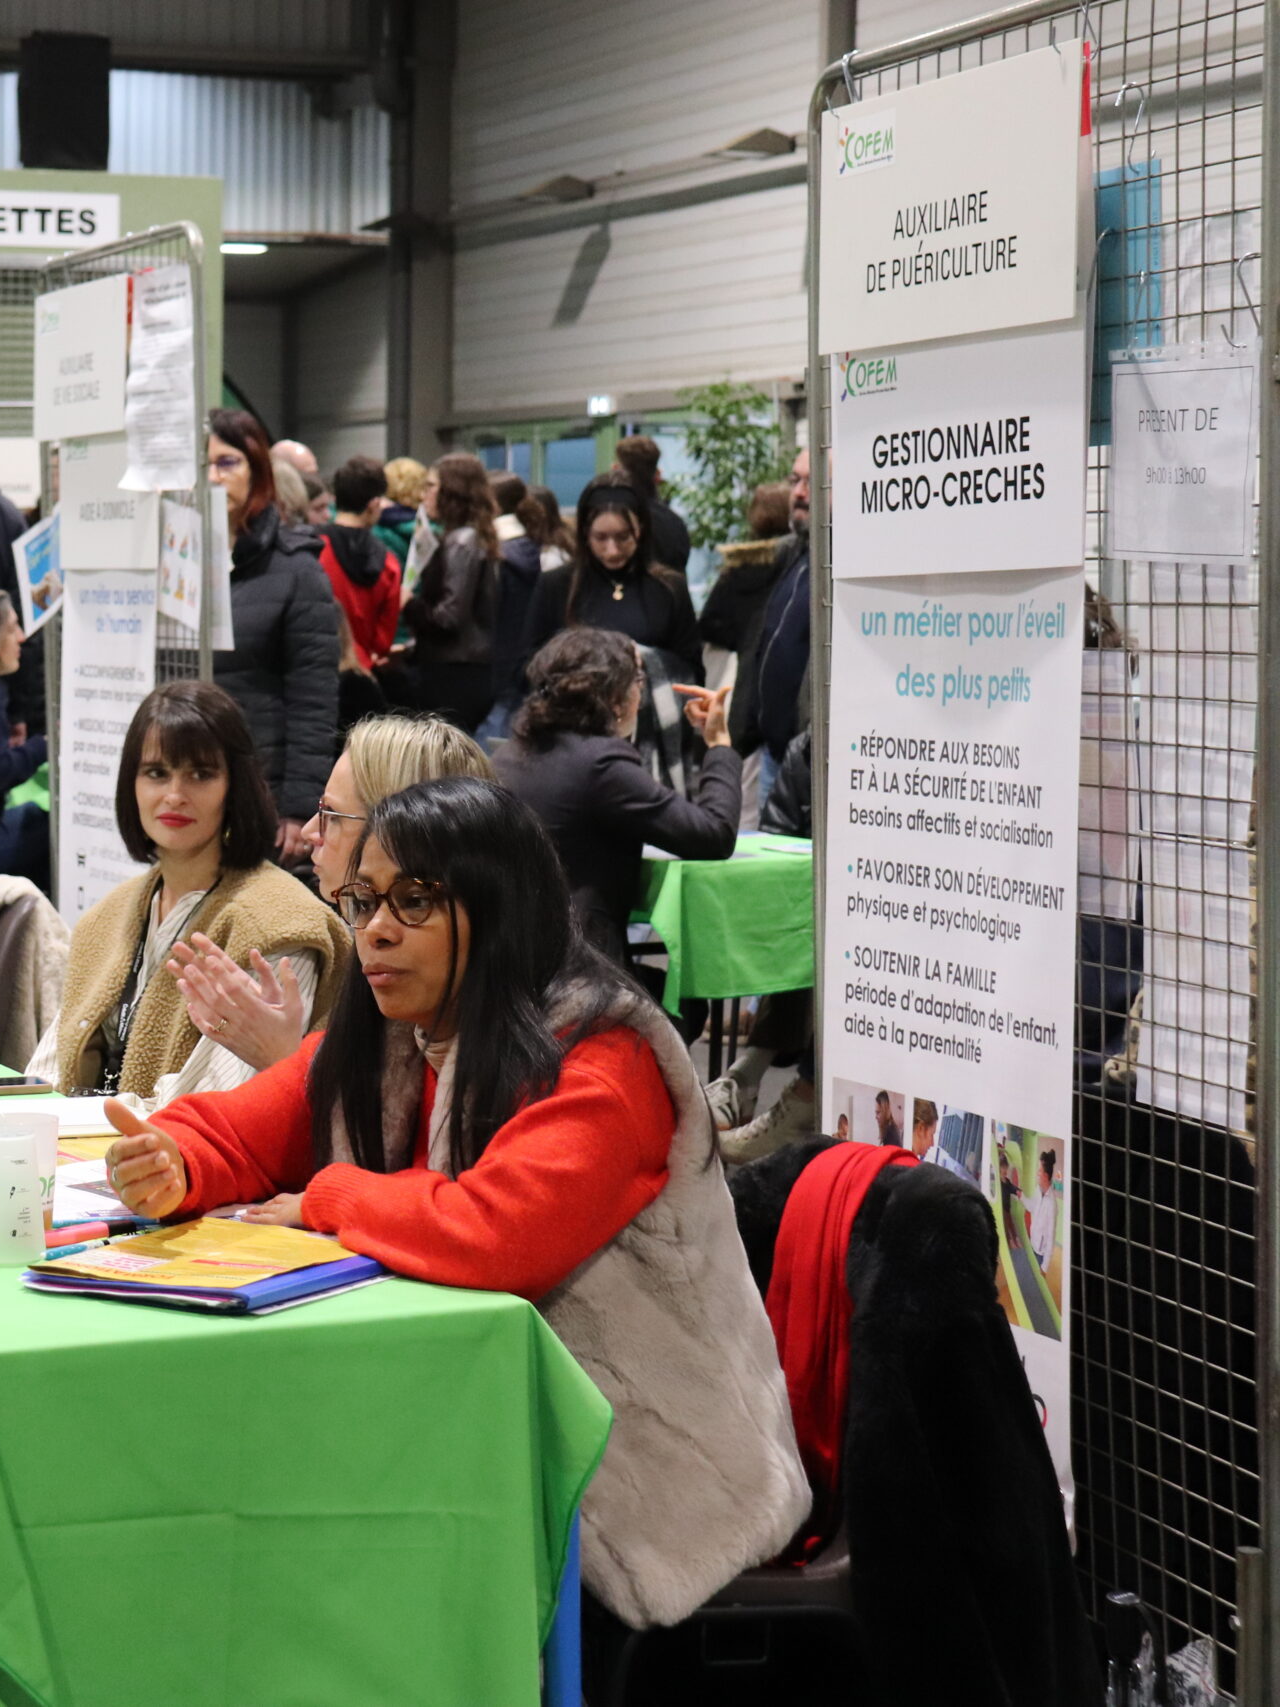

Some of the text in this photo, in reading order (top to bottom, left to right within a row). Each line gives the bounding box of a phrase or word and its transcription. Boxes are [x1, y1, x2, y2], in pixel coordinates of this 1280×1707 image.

[845, 128, 893, 168] COFEM
[893, 190, 988, 240] AUXILIAIRE
[866, 235, 1017, 293] DE PUÉRICULTURE
[846, 356, 898, 397] COFEM
[872, 416, 1030, 468] GESTIONNAIRE
[1195, 407, 1219, 431] DE
[861, 462, 1045, 514] MICRO-CRECHES
[1146, 467, 1166, 484] 9h00
[1174, 466, 1206, 484] 13h00
[860, 599, 1066, 646] un métier pour l'éveil
[896, 663, 1031, 709] des plus petits
[860, 729, 1020, 770] RÉPONDRE AUX BESOINS
[850, 763, 1042, 809] ET À LA SÉCURITÉ DE L'ENFANT
[849, 802, 1053, 849] besoins affectifs et socialisation
[856, 857, 1065, 911] FAVORISER SON DÉVELOPPEMENT
[847, 891, 1021, 943] physique et psychologique
[854, 945, 997, 994] SOUTENIR LA FAMILLE
[845, 978, 1059, 1050] période d'adaptation de l'enfant,
[844, 1013, 982, 1064] aide à la parentalité
